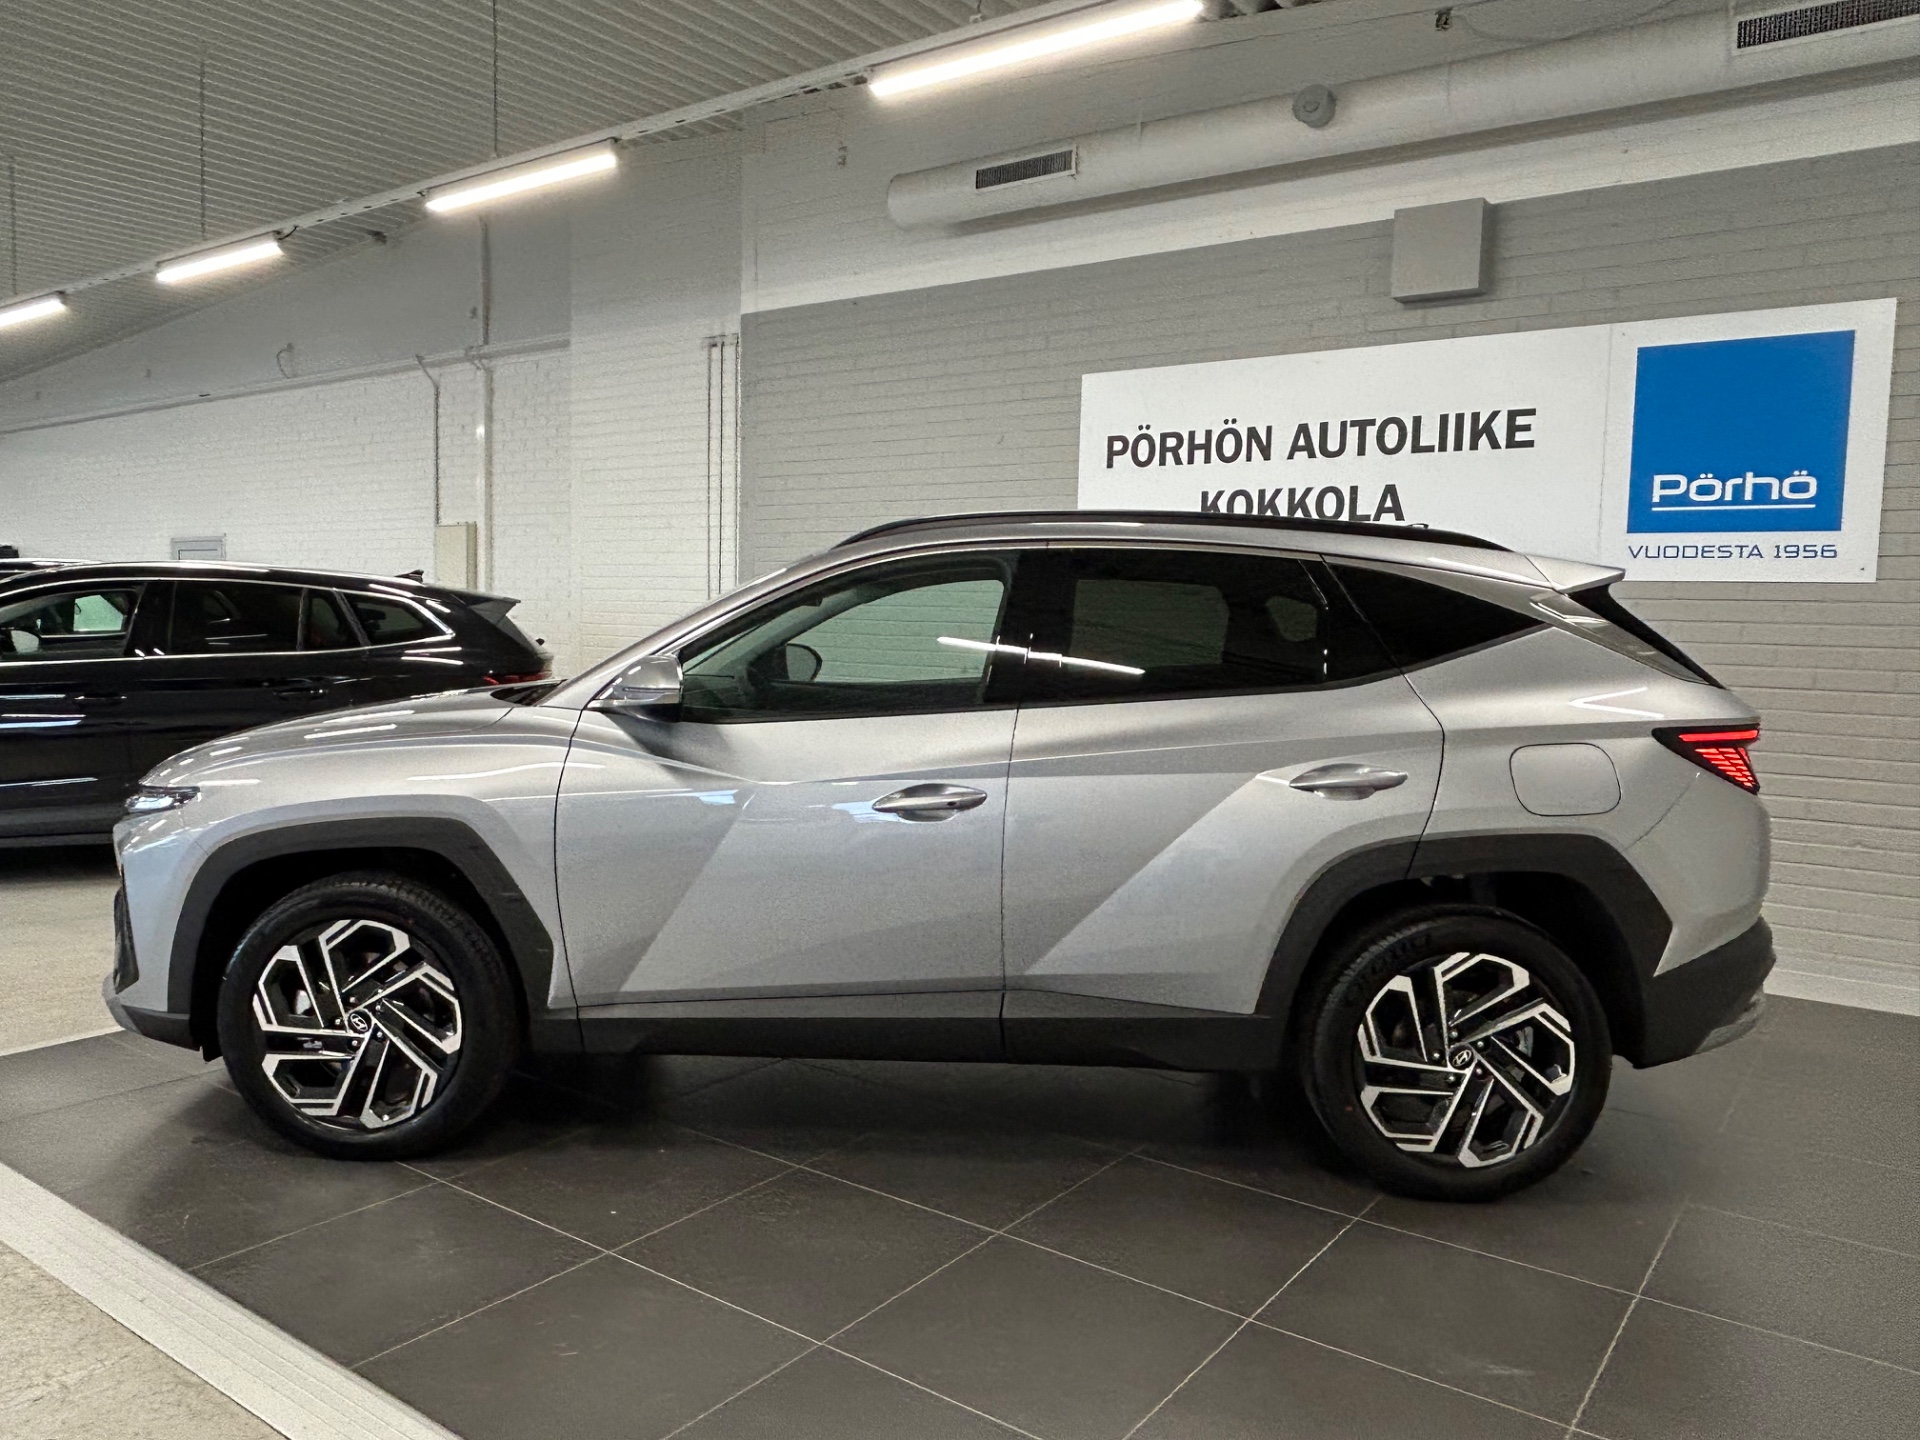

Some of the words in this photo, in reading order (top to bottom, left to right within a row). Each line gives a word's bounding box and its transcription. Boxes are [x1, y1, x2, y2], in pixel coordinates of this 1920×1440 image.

[1106, 418, 1273, 469] PÖRHÖN
[1286, 408, 1537, 460] AUTOLIIKE
[1200, 484, 1406, 522] KOKKOLA
[1652, 470, 1818, 503] Pörhö
[1628, 544, 1764, 559] VUODESTA
[1773, 544, 1838, 559] 1956
